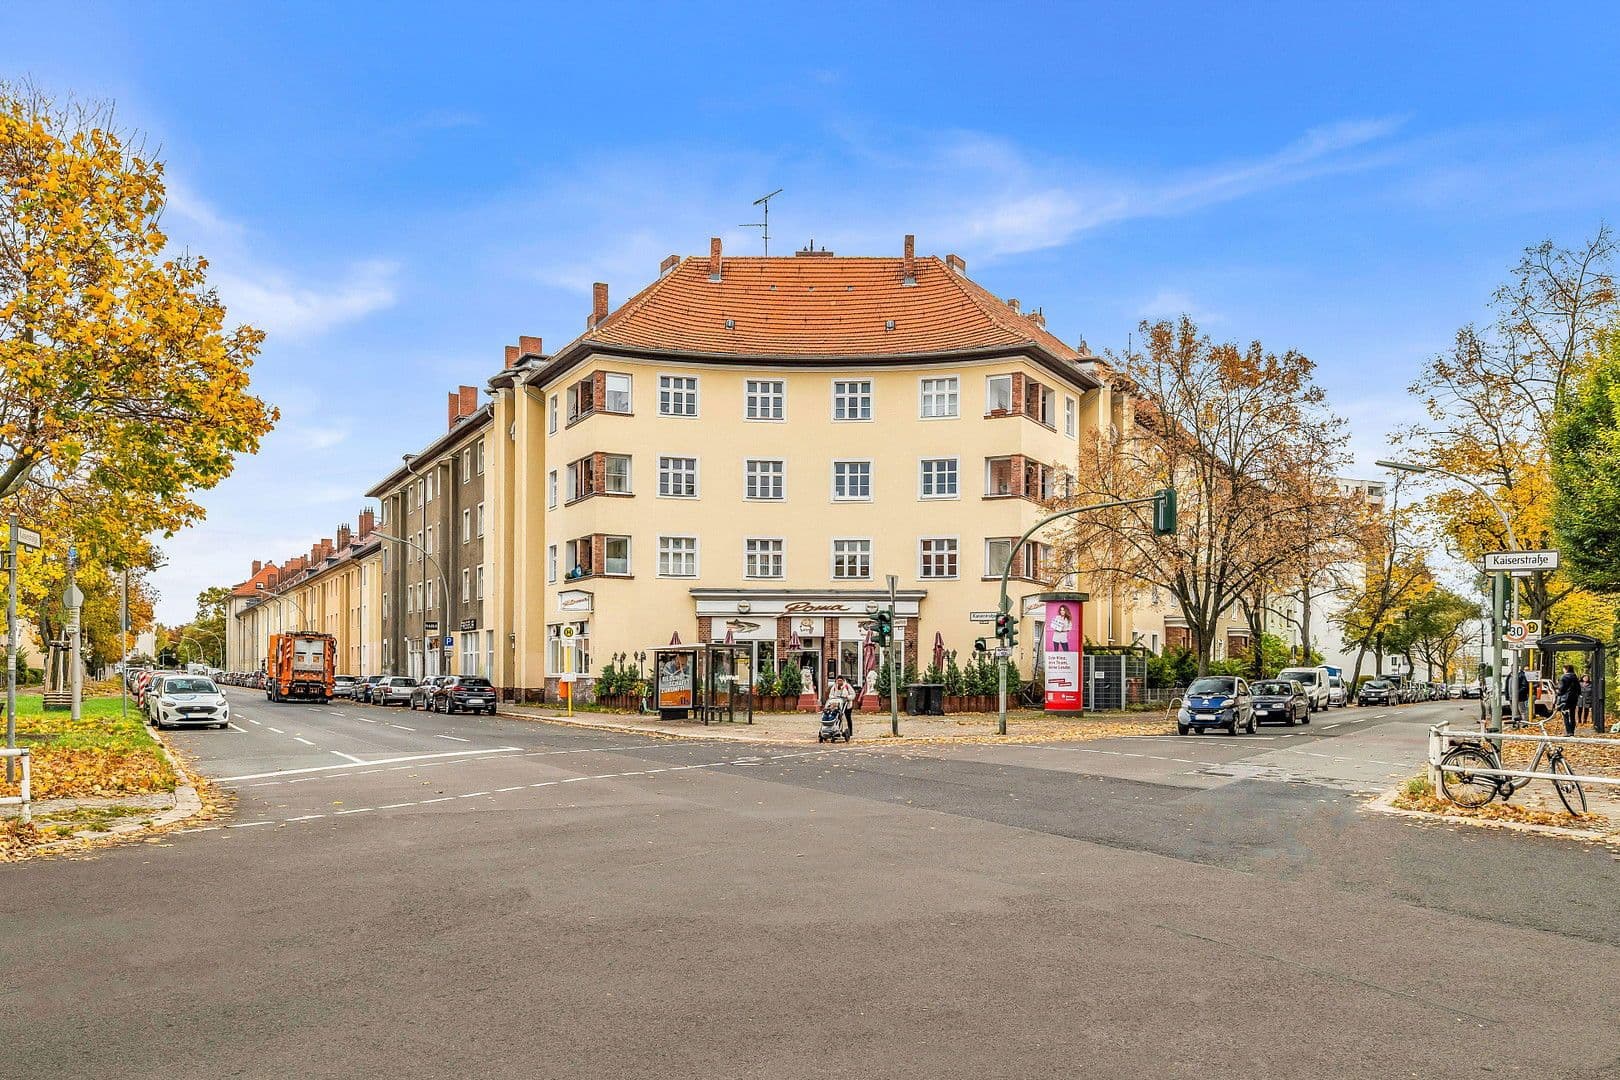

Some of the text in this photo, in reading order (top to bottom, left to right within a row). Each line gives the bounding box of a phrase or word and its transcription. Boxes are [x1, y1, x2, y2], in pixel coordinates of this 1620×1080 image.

[1493, 554, 1549, 566] Kaiserstraße
[785, 601, 850, 613] Roma
[1510, 626, 1523, 637] 30
